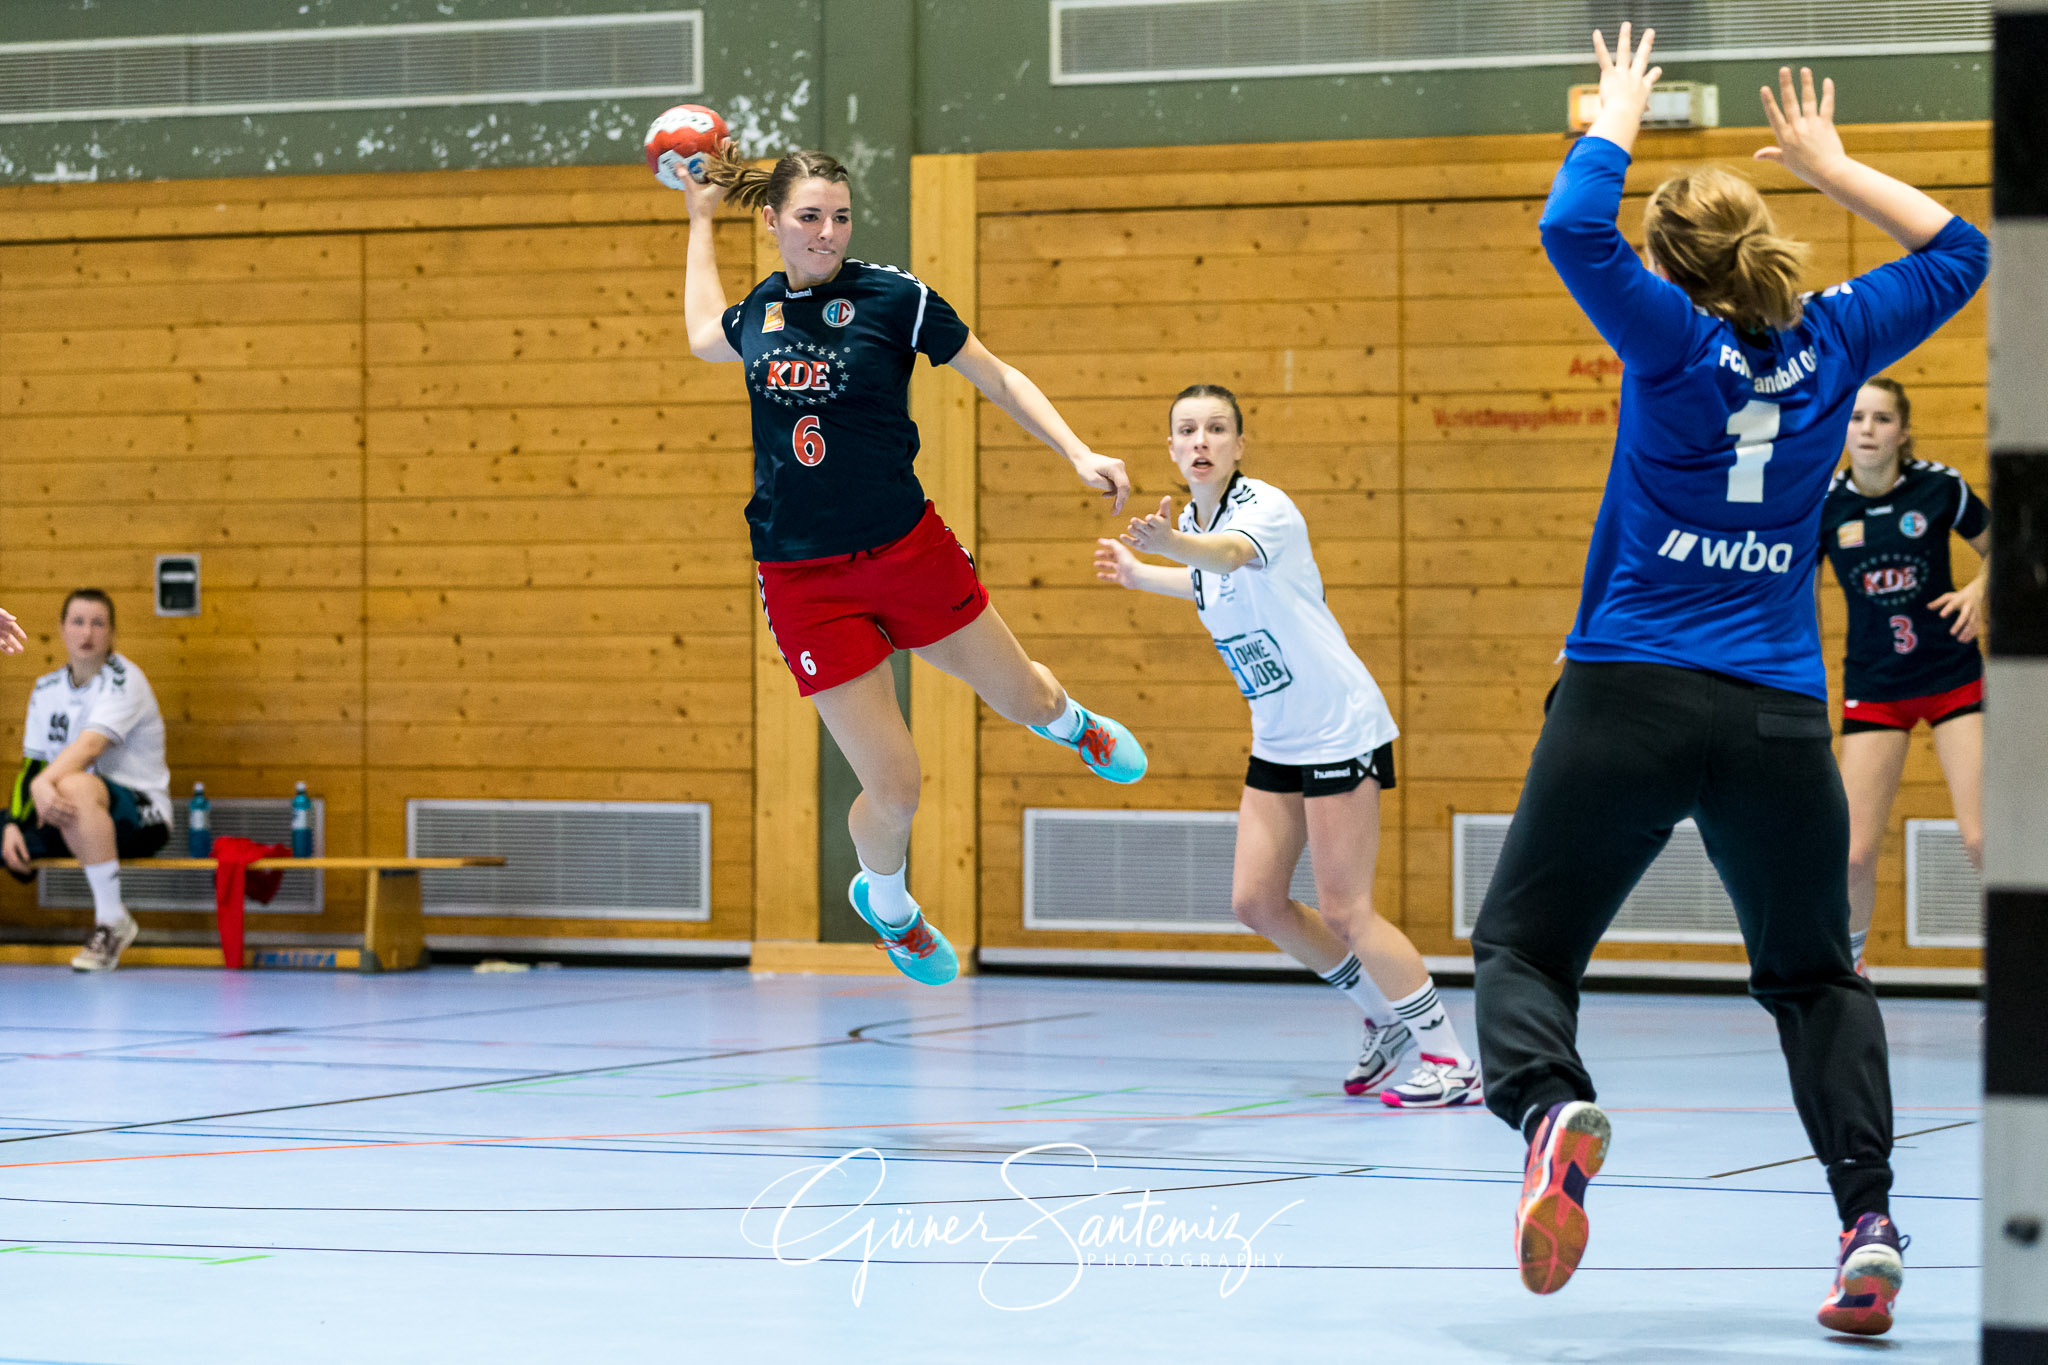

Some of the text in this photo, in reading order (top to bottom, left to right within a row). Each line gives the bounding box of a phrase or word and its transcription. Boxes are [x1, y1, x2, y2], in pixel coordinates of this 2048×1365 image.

[766, 360, 831, 391] KDE
[792, 414, 827, 467] 6
[1726, 399, 1780, 503] 1
[1701, 530, 1793, 573] wba
[1863, 566, 1918, 596] KDE
[1889, 614, 1919, 655] 3
[800, 650, 817, 676] 6
[1234, 640, 1271, 665] OHNE
[1250, 660, 1285, 688] JOB
